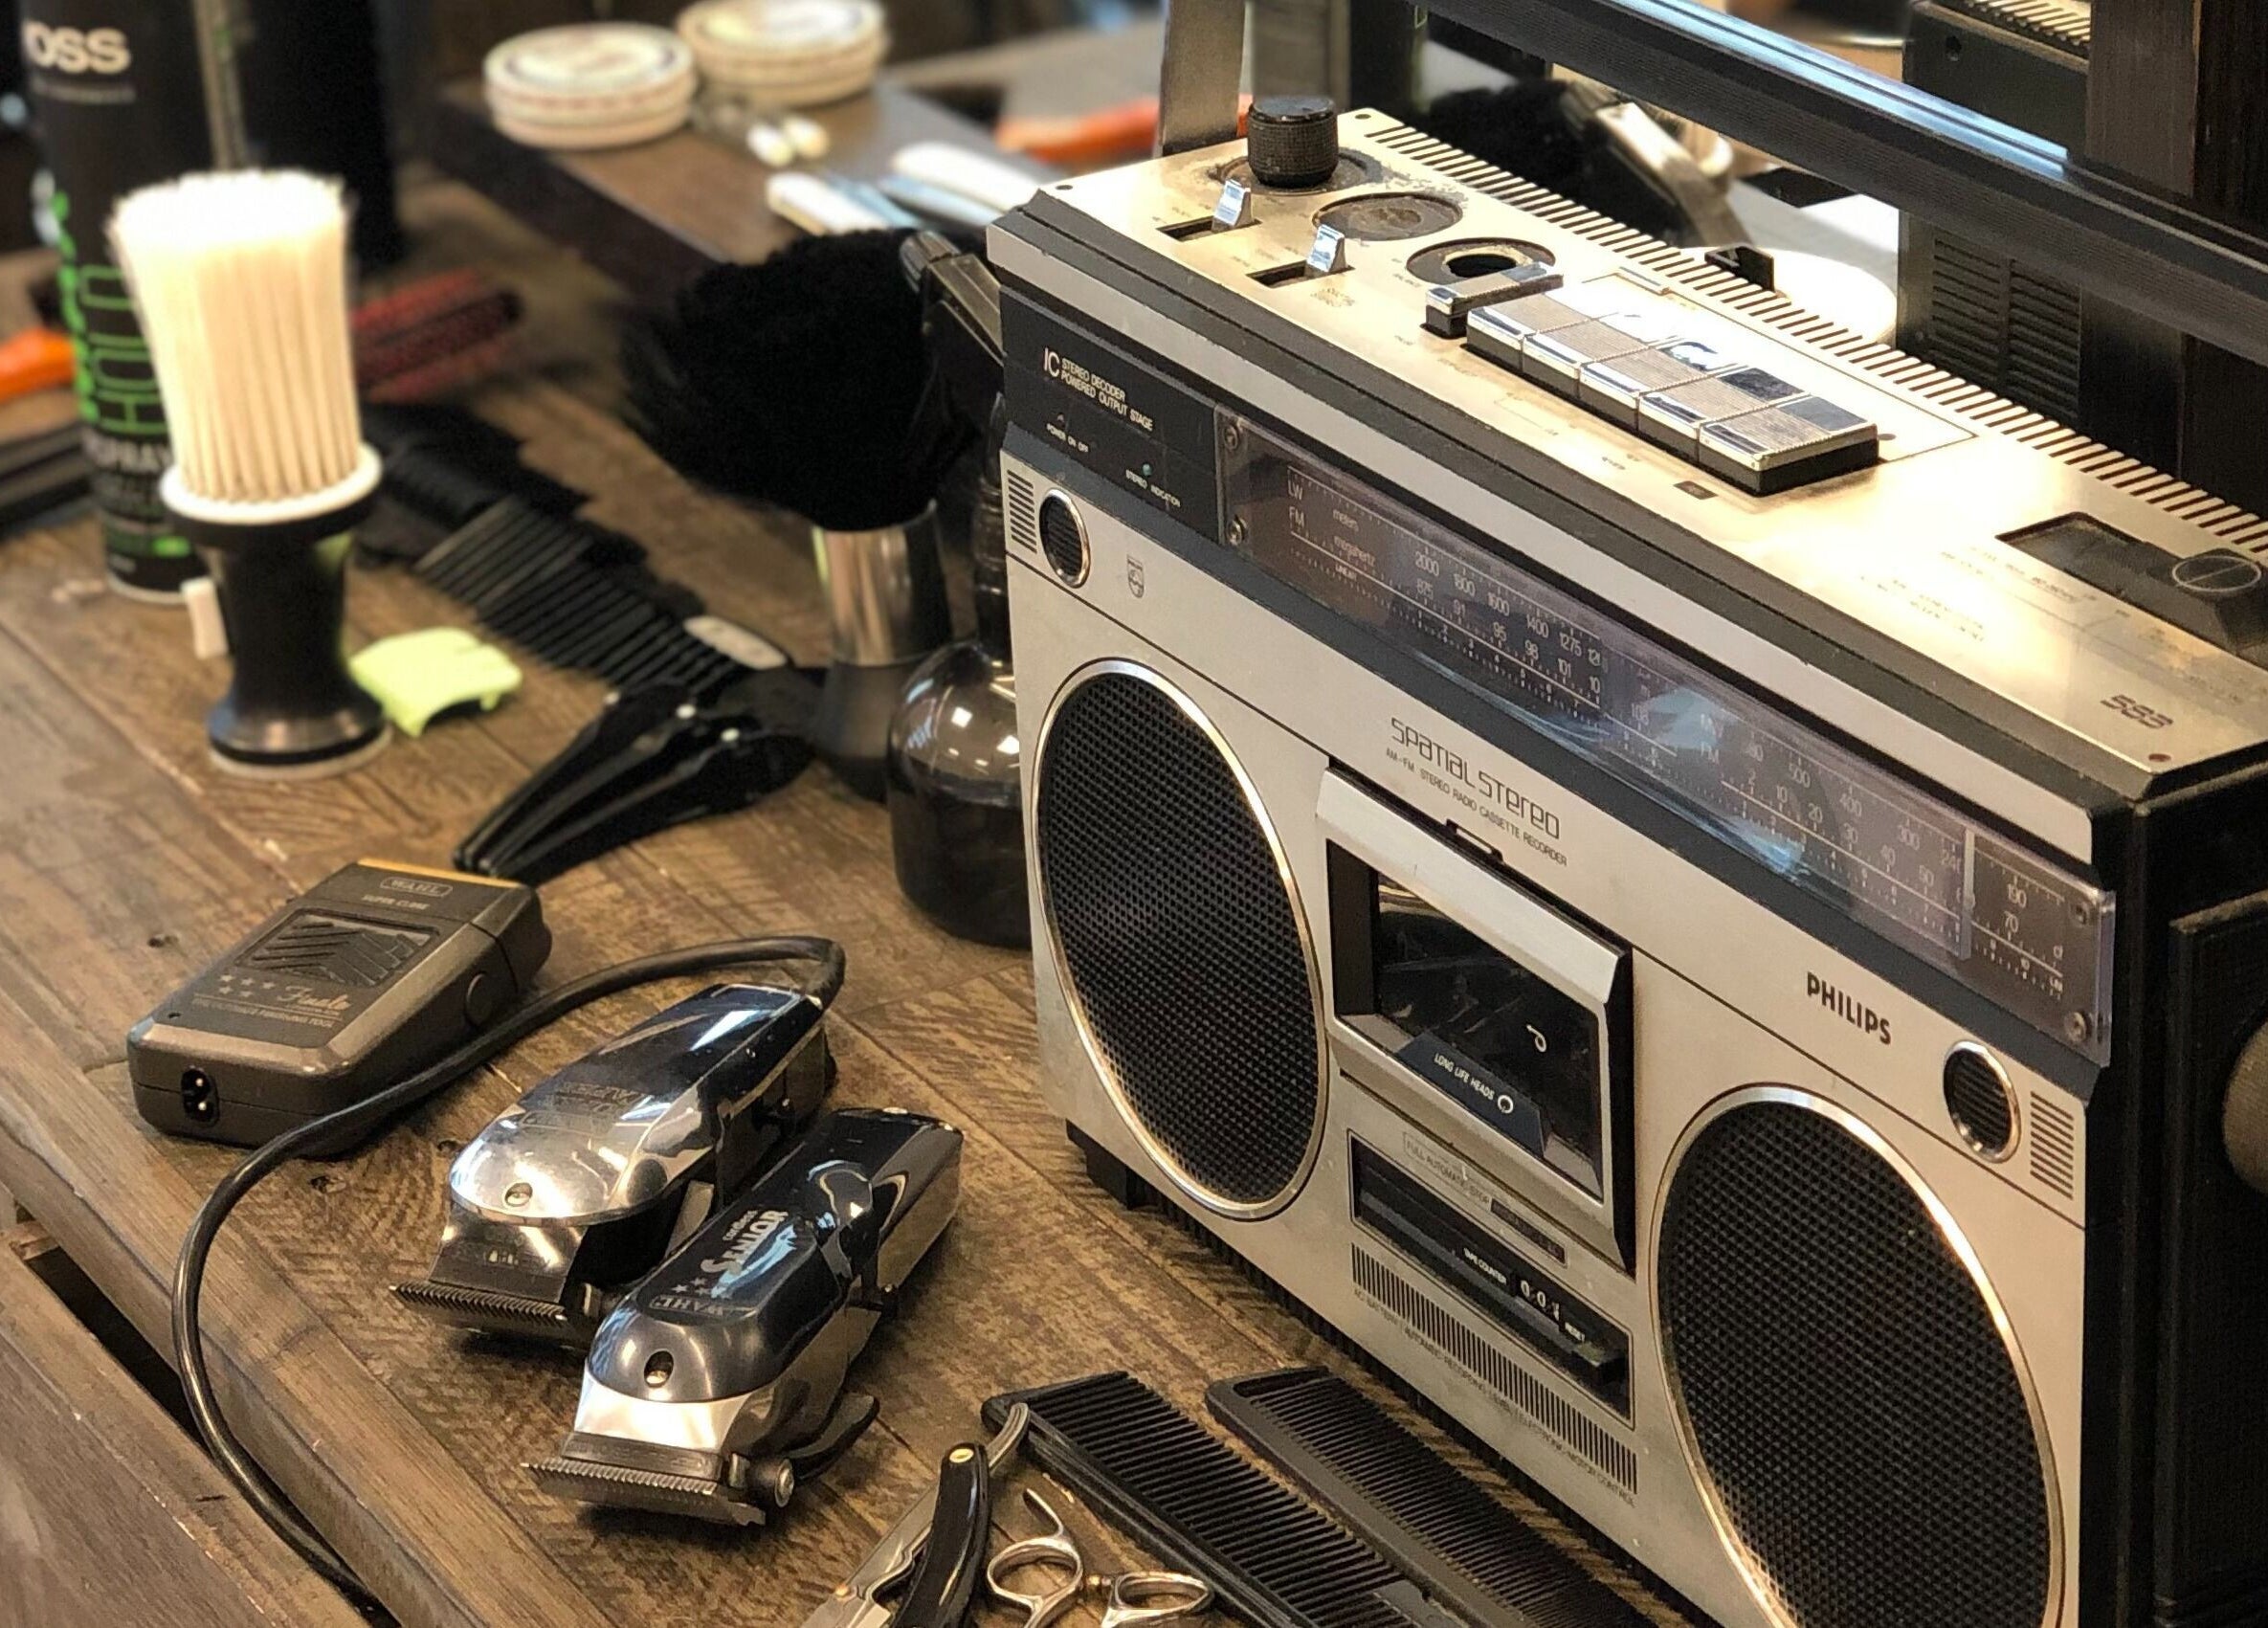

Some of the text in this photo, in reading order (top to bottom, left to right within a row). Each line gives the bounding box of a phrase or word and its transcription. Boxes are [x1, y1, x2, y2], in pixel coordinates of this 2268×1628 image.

[1044, 347, 1060, 377] IC
[1061, 358, 1126, 403] STEREO DECODER
[1061, 370, 1154, 431] POWERED OUTPUT STAGE
[1416, 551, 1439, 576] 2000
[1526, 613, 1548, 638] 1400
[1559, 633, 1582, 657] 1275
[1419, 769, 1451, 794] STEREO
[1452, 788, 1477, 812] RADIO
[1479, 805, 1521, 839] CASSETTE
[1523, 831, 1568, 867] RECORDER
[1807, 970, 1892, 1045] PHILIPS
[1434, 1053, 1495, 1101] LONG LIFE HEADS
